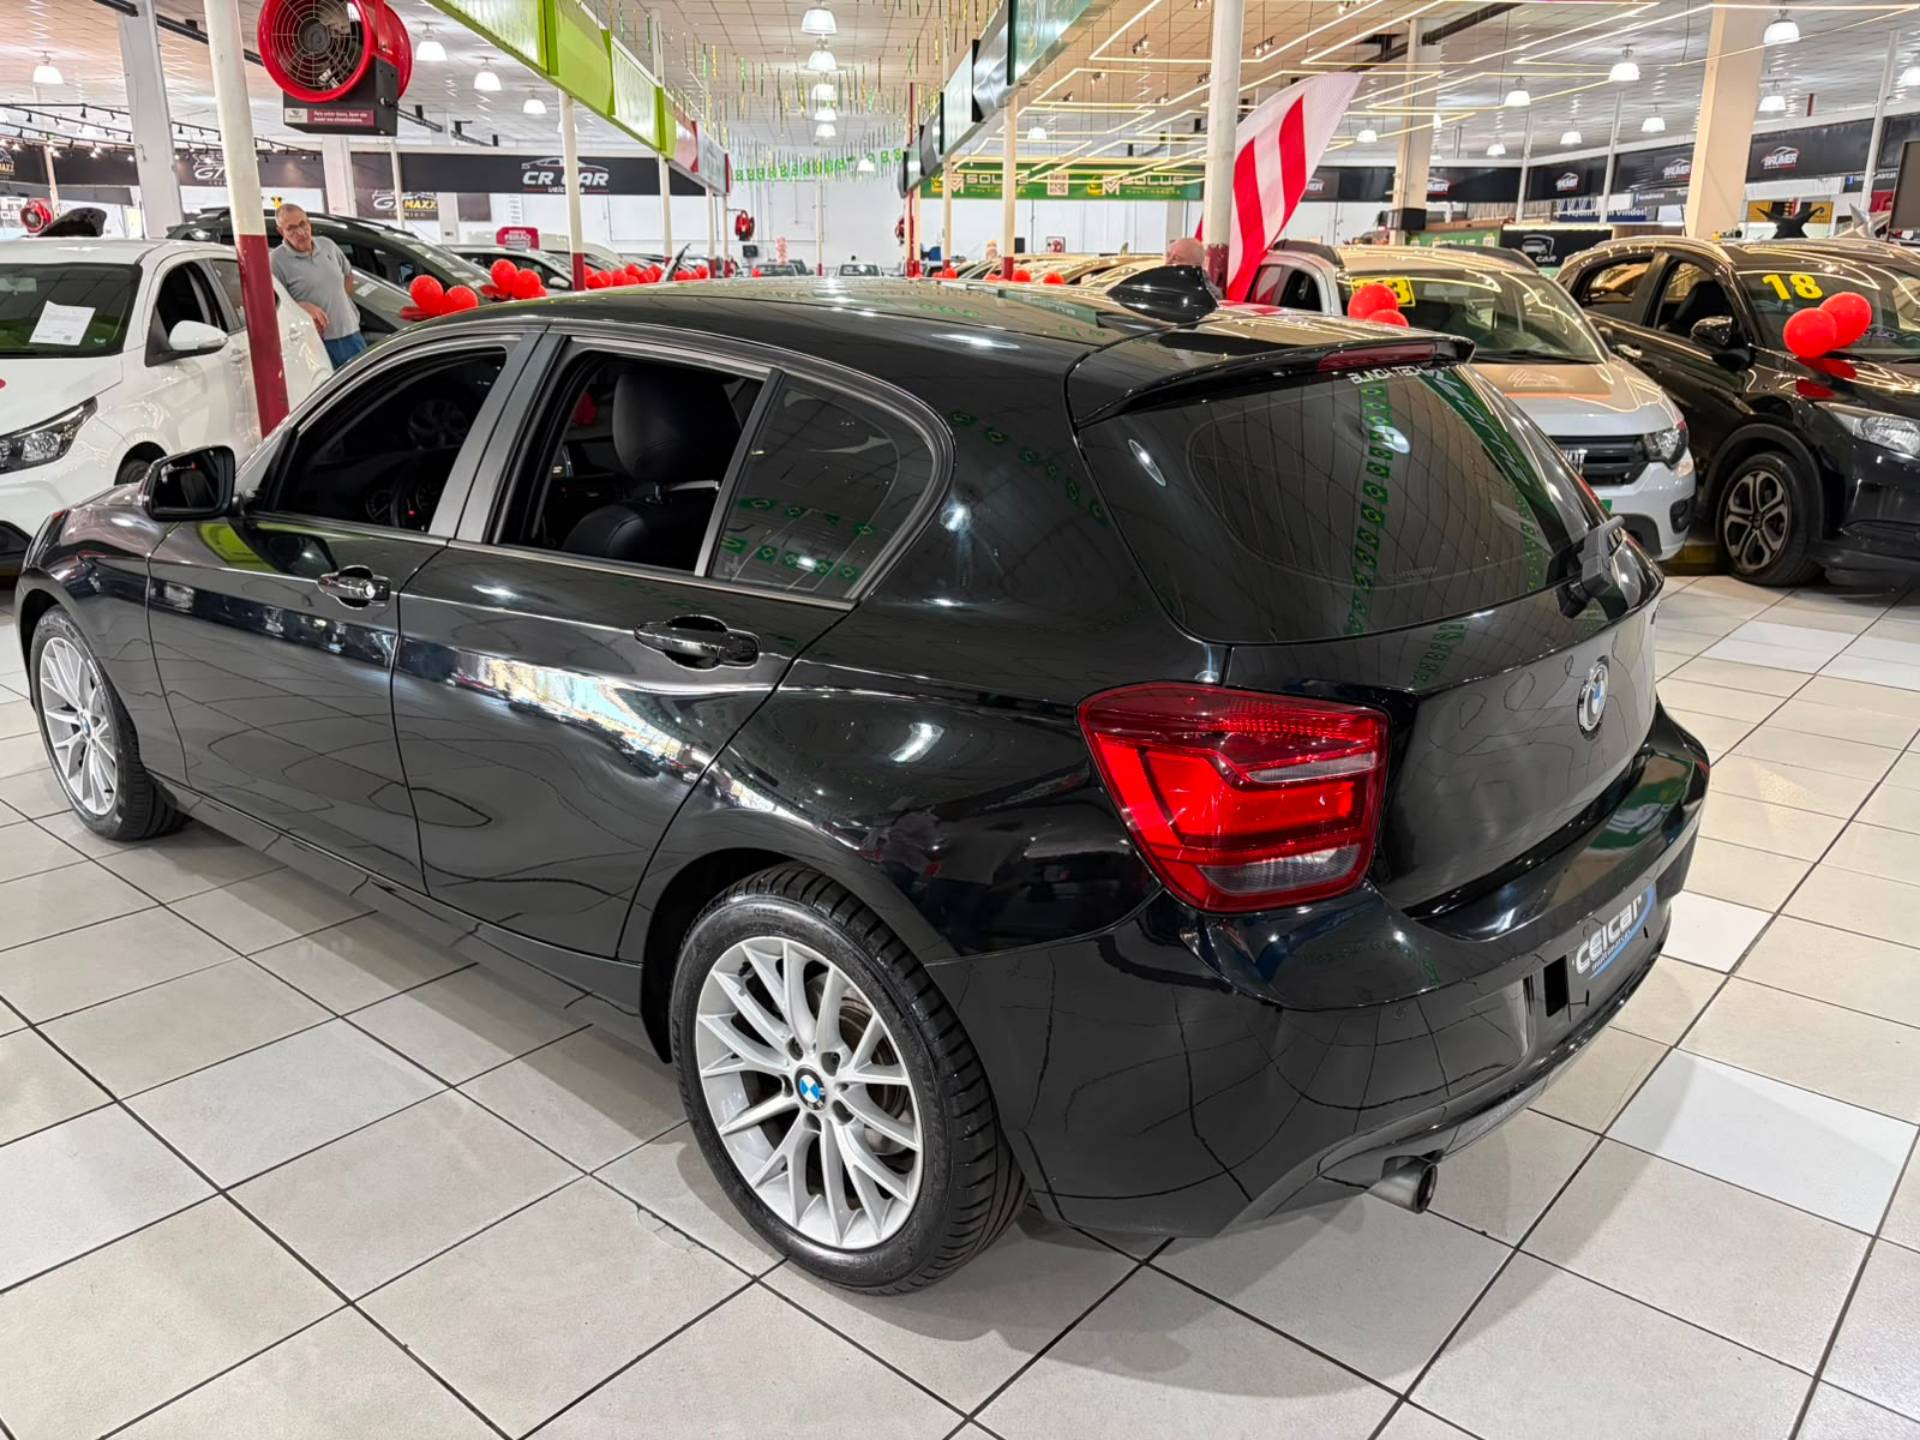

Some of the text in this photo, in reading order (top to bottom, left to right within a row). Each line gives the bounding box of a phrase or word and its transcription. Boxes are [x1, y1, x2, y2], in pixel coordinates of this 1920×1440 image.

[522, 171, 554, 185] CR
[966, 174, 1029, 184] SOLS
[1762, 273, 1823, 300] 18
